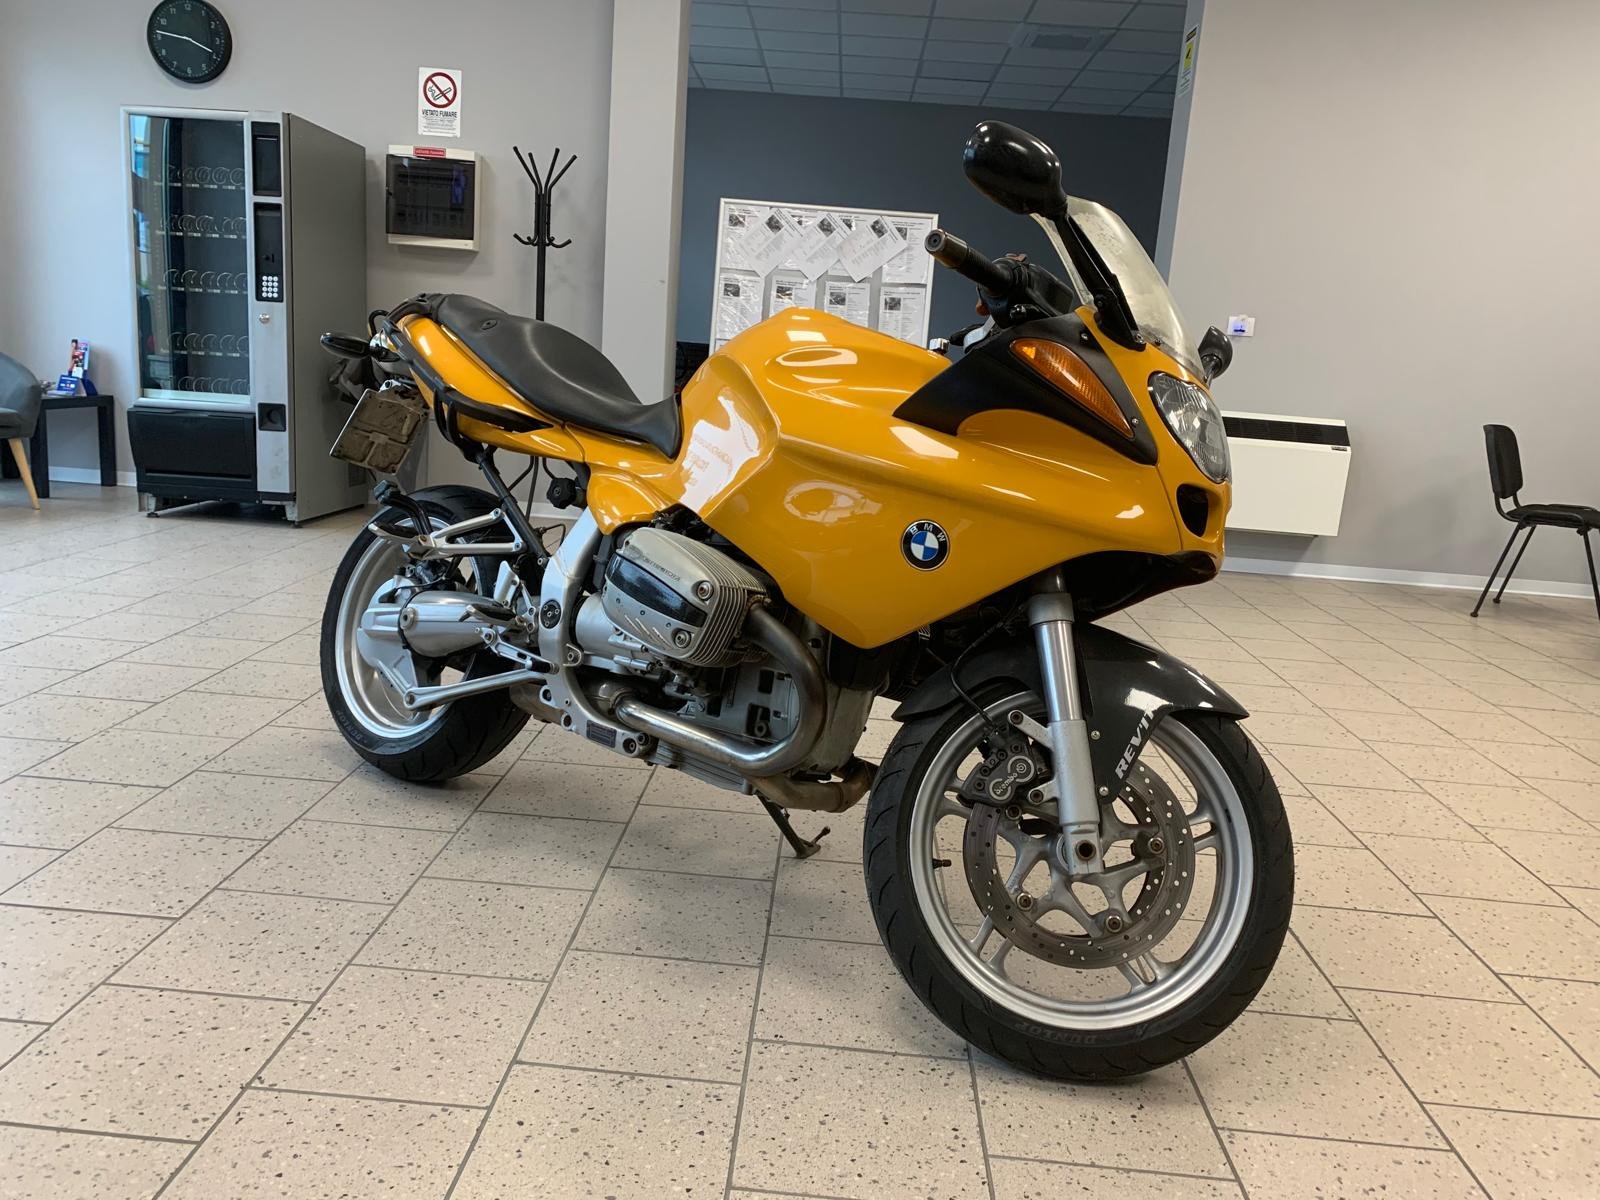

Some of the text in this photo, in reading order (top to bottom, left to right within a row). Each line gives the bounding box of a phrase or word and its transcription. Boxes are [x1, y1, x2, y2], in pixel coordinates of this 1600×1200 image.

[421, 109, 458, 118] VIETATO FUMARE
[910, 523, 946, 542] BMW
[993, 772, 1018, 795] brembo
[1014, 1022, 1097, 1044] DUNLOP
